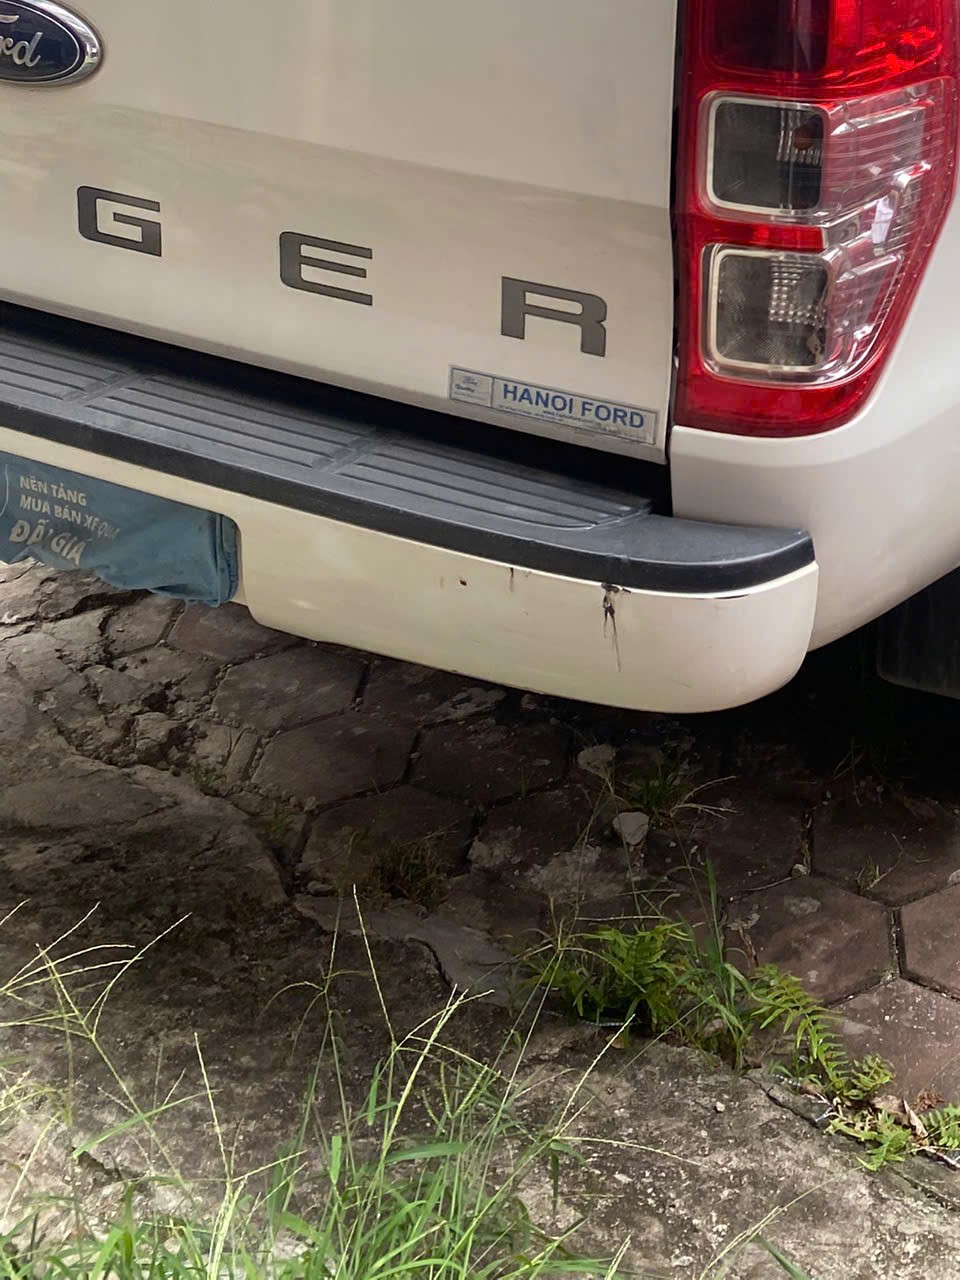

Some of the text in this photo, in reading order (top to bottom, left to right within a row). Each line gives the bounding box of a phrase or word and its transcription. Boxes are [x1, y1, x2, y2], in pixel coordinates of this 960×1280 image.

[503, 383, 574, 414] HANOI
[580, 401, 645, 429] FORD
[20, 494, 51, 515] MUA
[54, 505, 81, 525] BÁN
